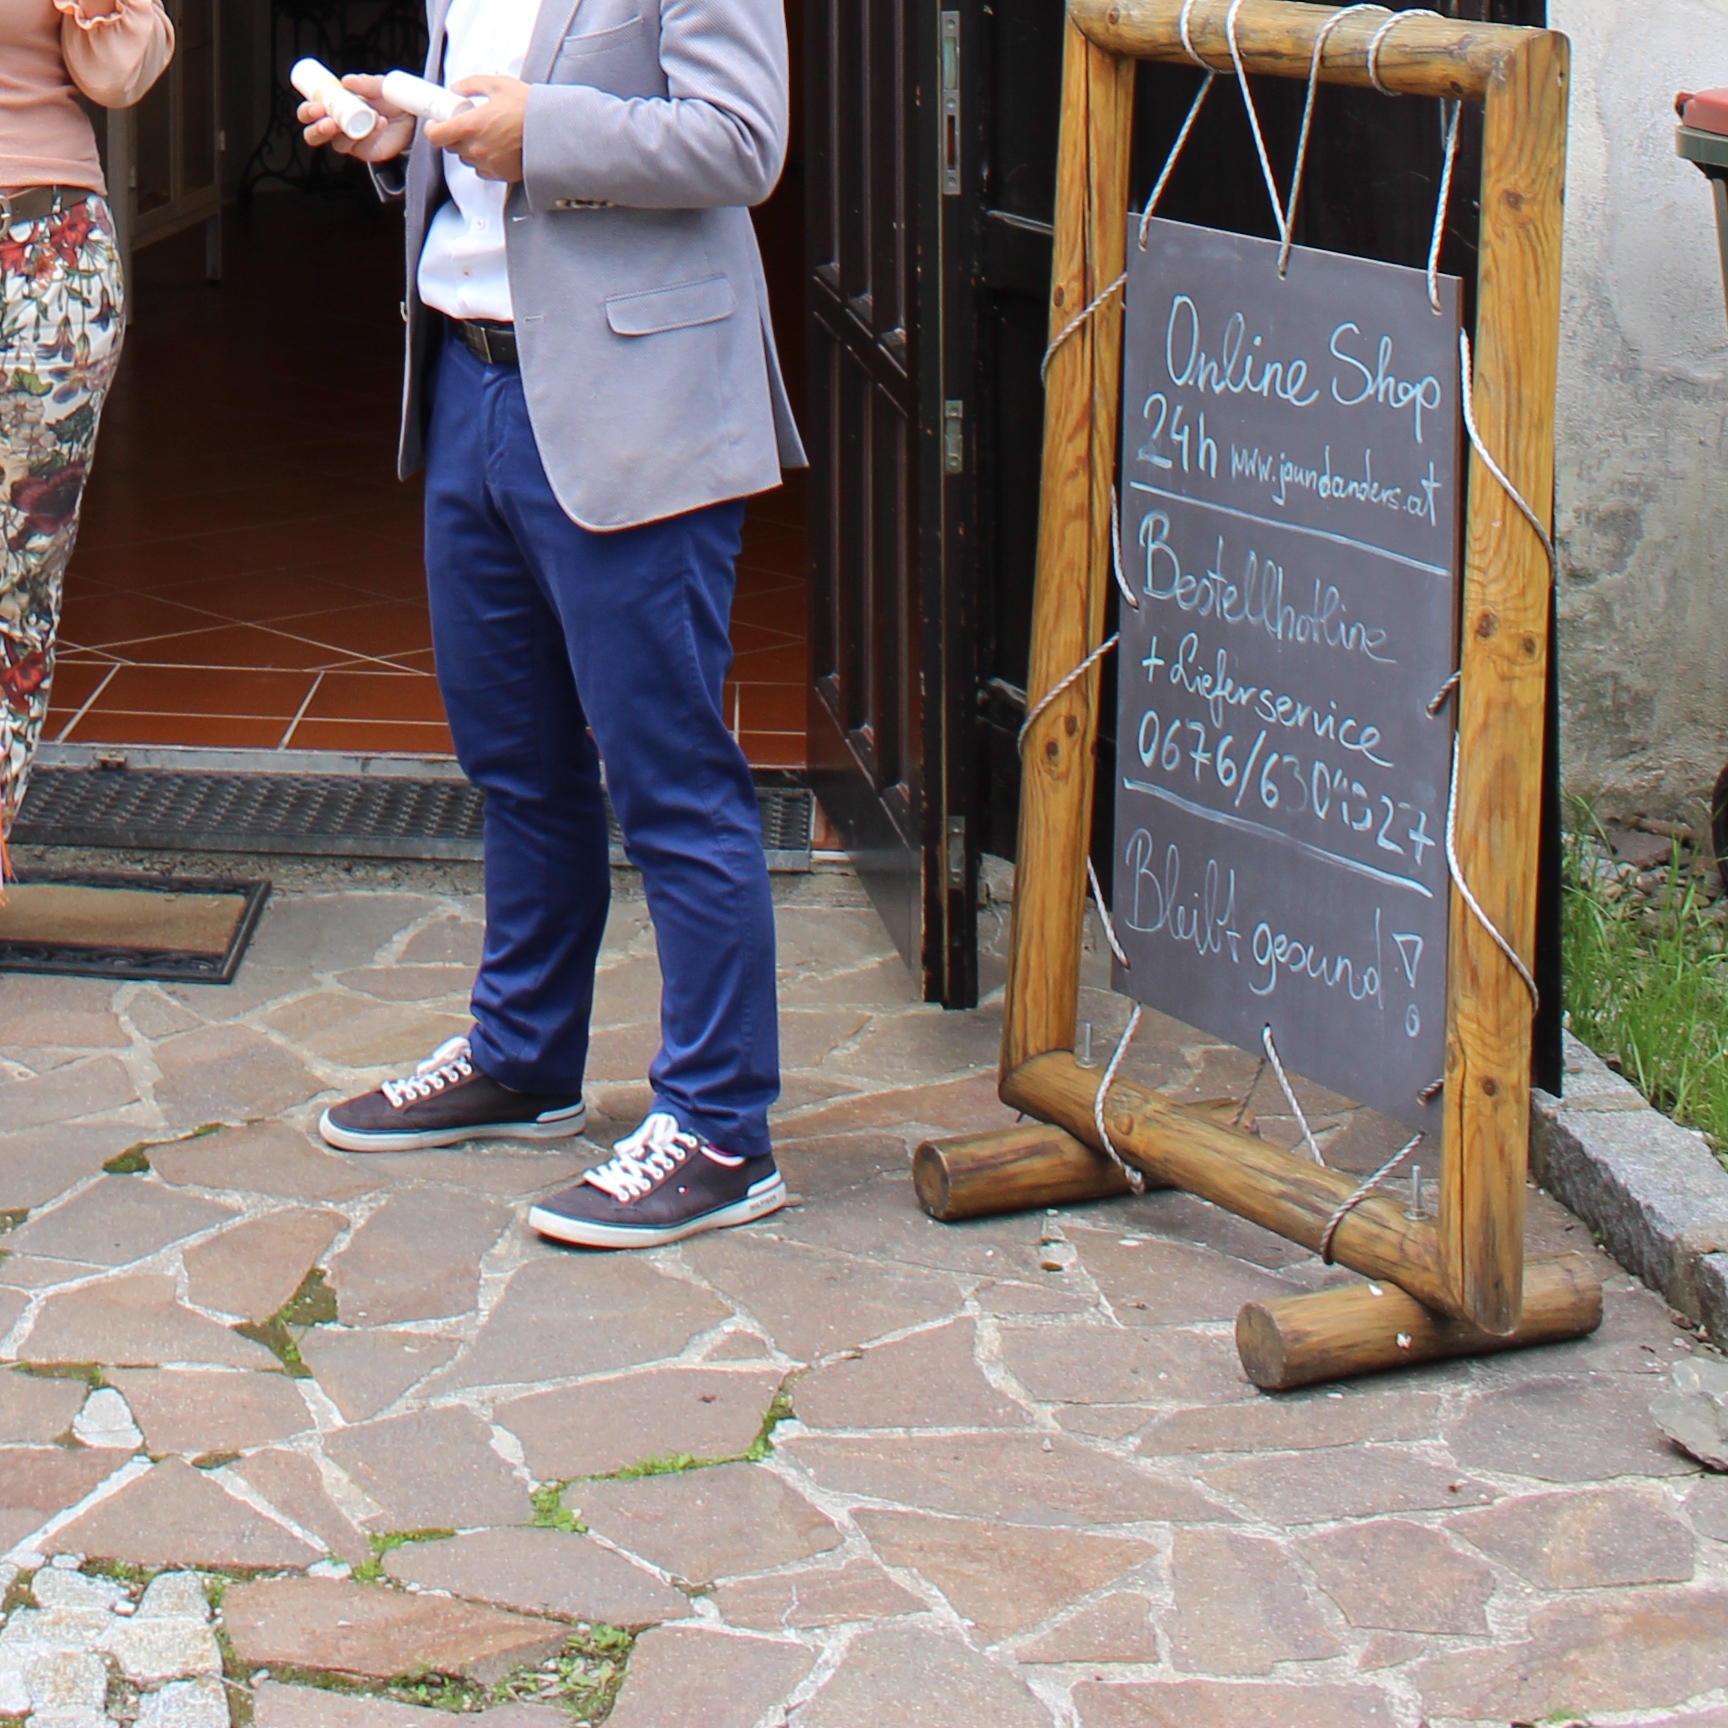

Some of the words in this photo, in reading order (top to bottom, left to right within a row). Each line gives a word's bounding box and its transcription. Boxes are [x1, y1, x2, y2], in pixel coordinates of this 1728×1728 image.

[1136, 392, 1218, 479] 24h
[1165, 294, 1320, 407] Online
[1329, 320, 1442, 444] Shop
[1138, 510, 1398, 664] Bestellhotline
[1141, 635, 1166, 683] +
[1169, 631, 1395, 768] Lieferservice
[1124, 827, 1242, 965] Bleibt
